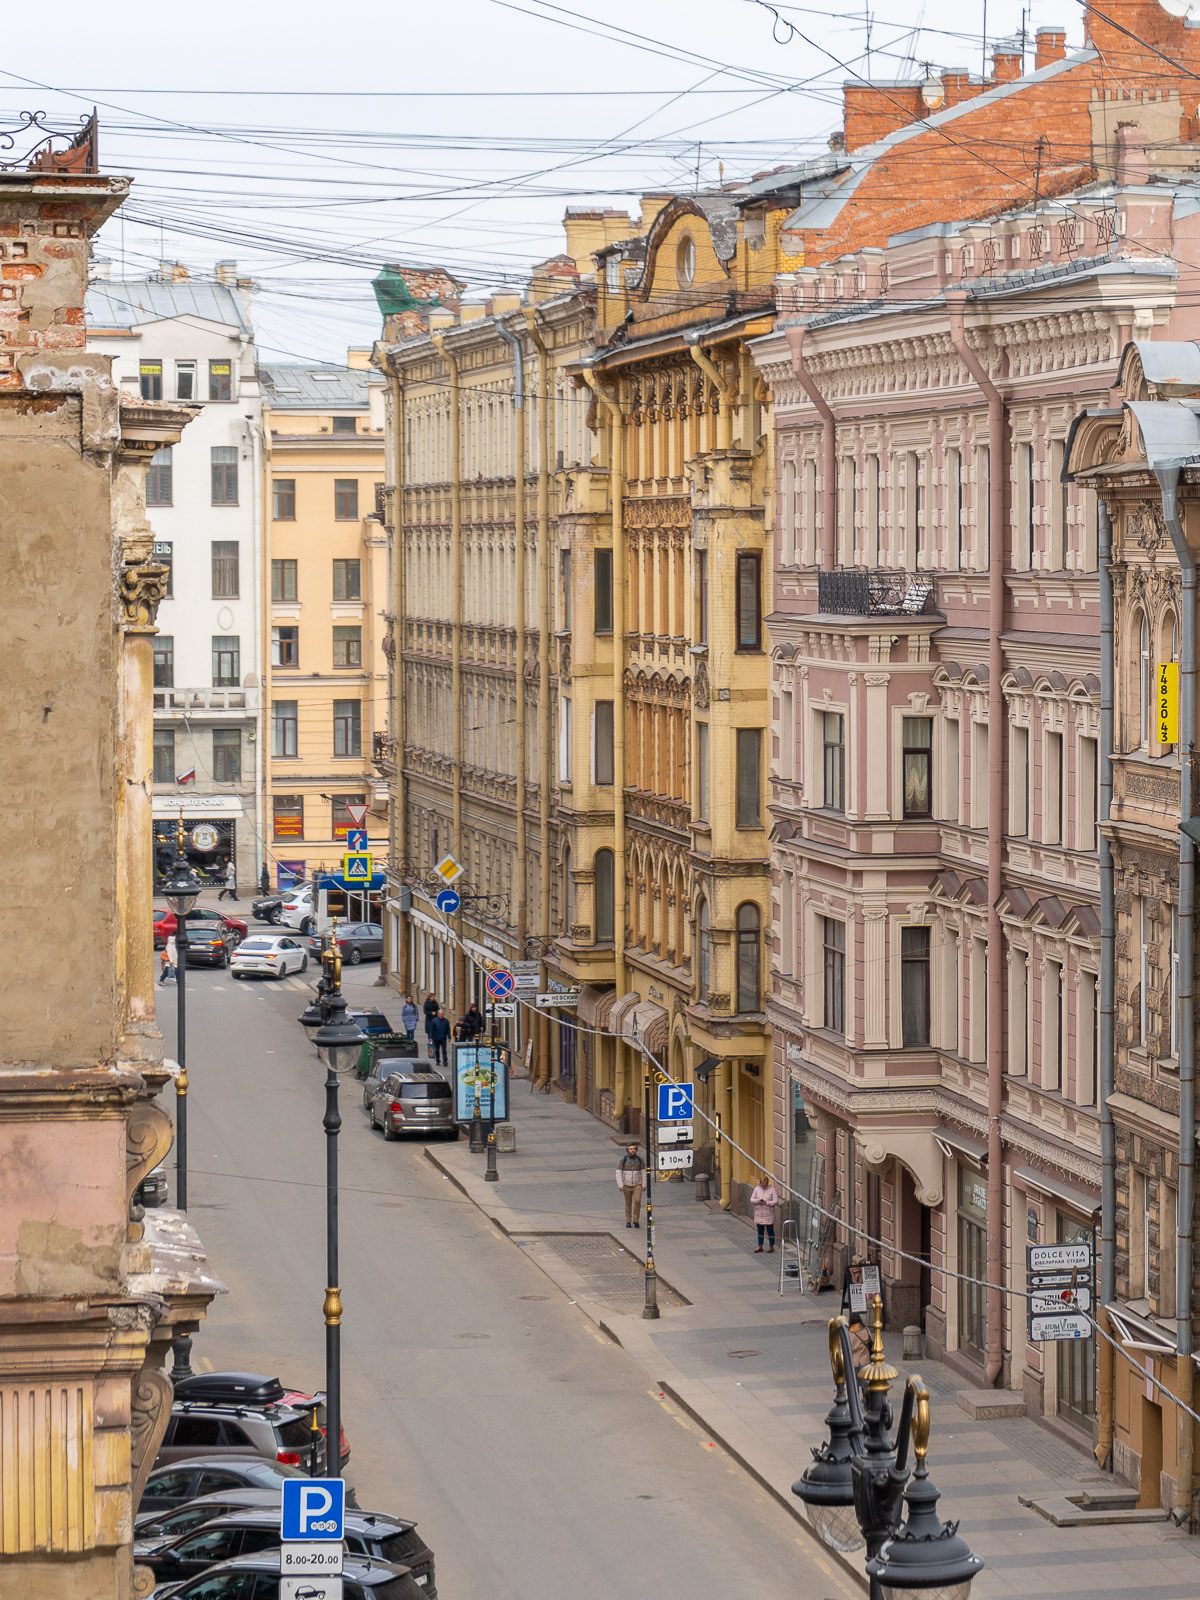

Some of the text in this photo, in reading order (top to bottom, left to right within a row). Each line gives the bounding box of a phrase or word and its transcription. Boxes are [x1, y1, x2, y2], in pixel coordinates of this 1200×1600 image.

[1160, 664, 1168, 742] 748 20 43
[163, 799, 224, 807] КОНДИТЕРСКАЯ
[1034, 1251, 1063, 1259] DOLCE
[300, 1486, 333, 1533] P
[327, 1522, 336, 1530] 20
[285, 1553, 339, 1565] 8.00-20.00
